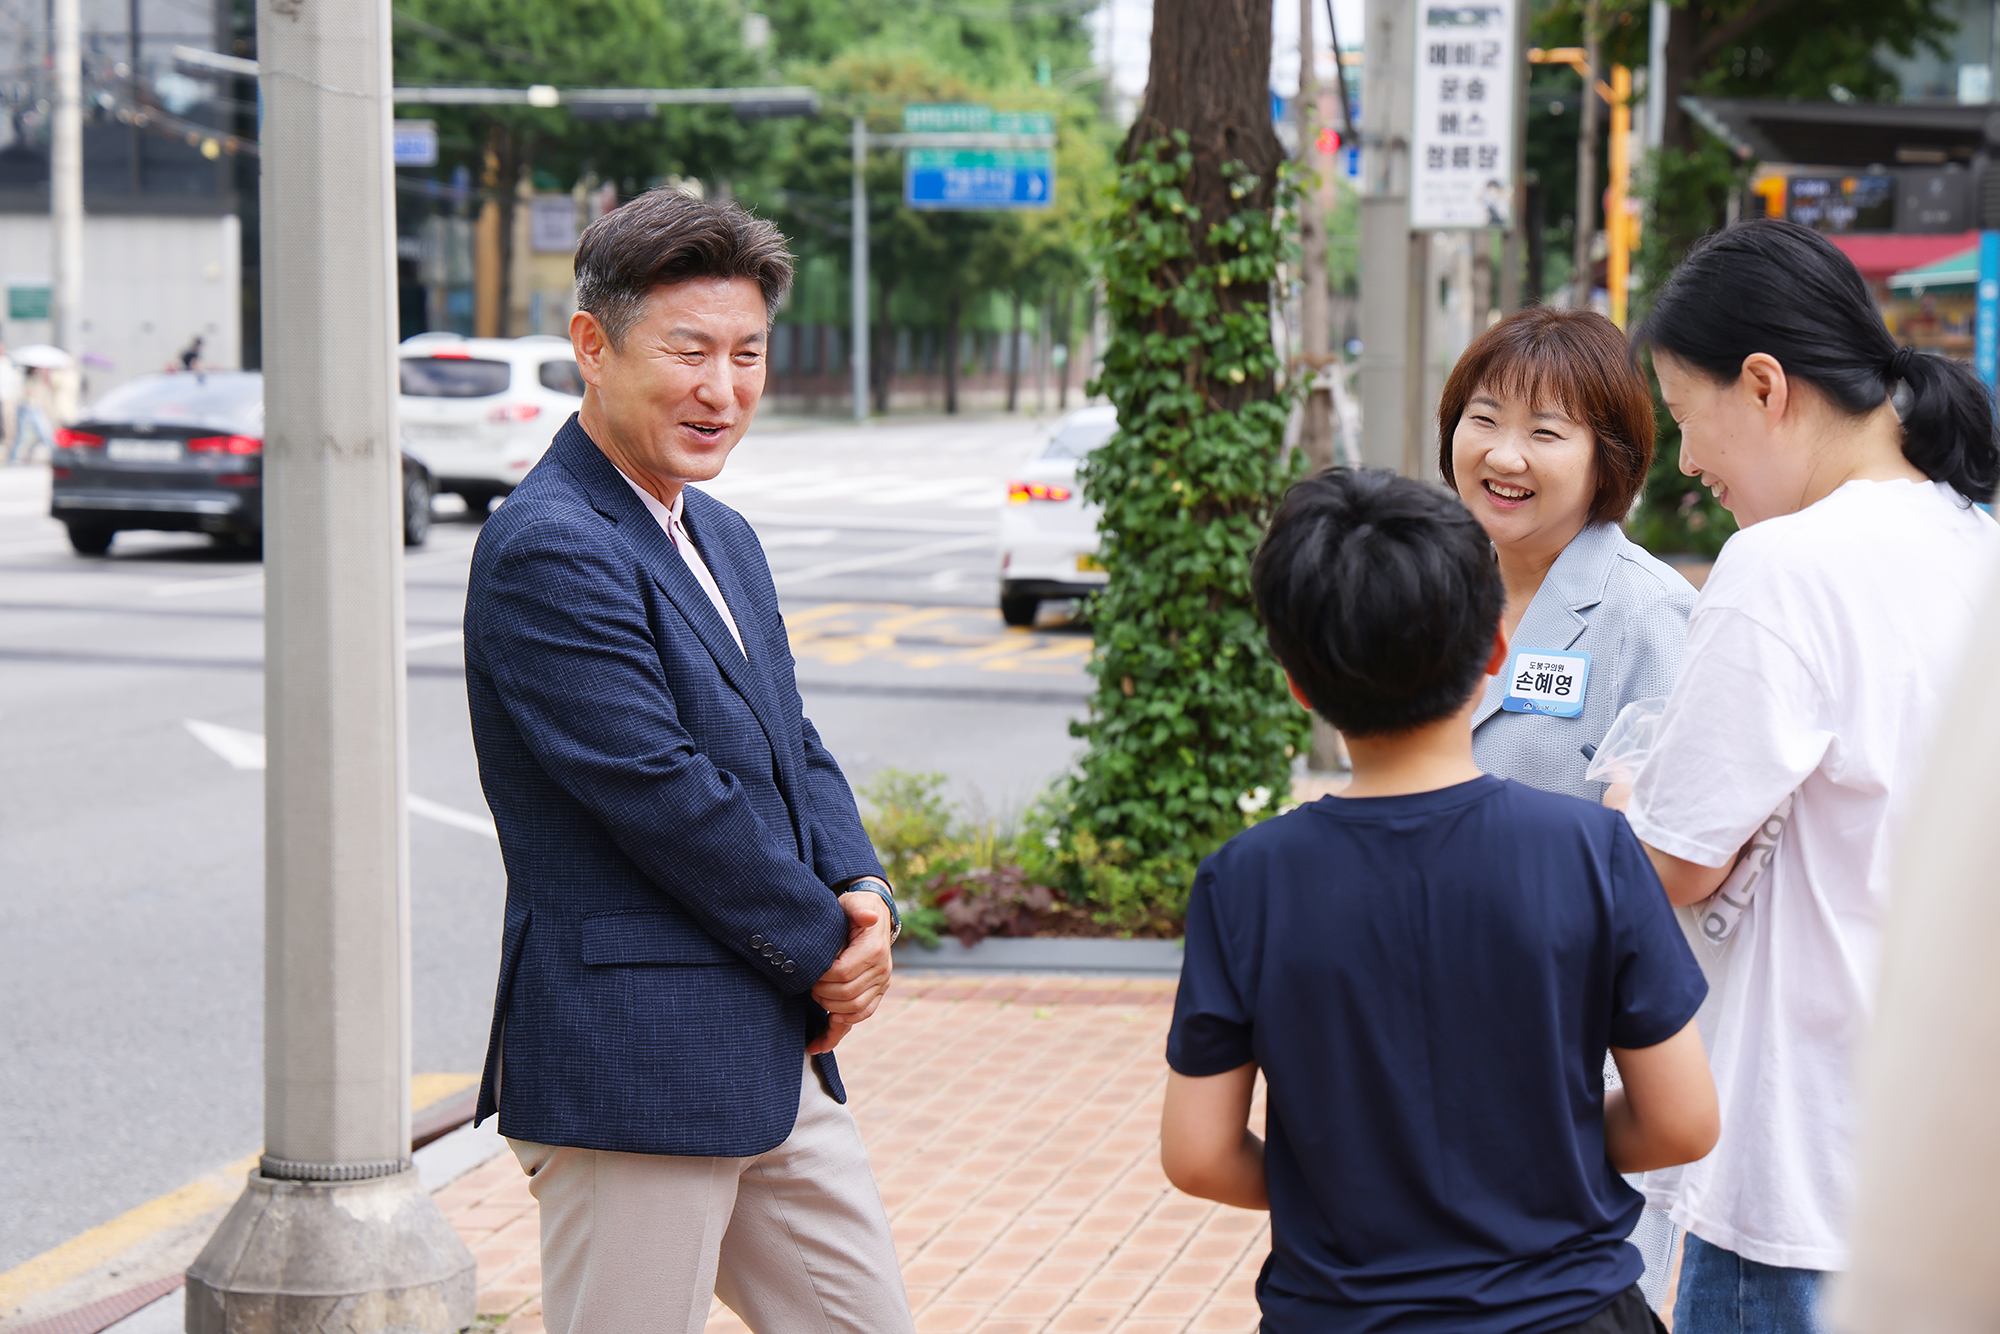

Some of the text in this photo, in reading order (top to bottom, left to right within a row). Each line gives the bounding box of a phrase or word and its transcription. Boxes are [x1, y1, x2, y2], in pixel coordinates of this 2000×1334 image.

[1428, 41, 1500, 66] 예비군
[1438, 112, 1486, 135] 버스
[1529, 661, 1565, 672] 도봉구의원
[1515, 670, 1573, 696] 손혜영
